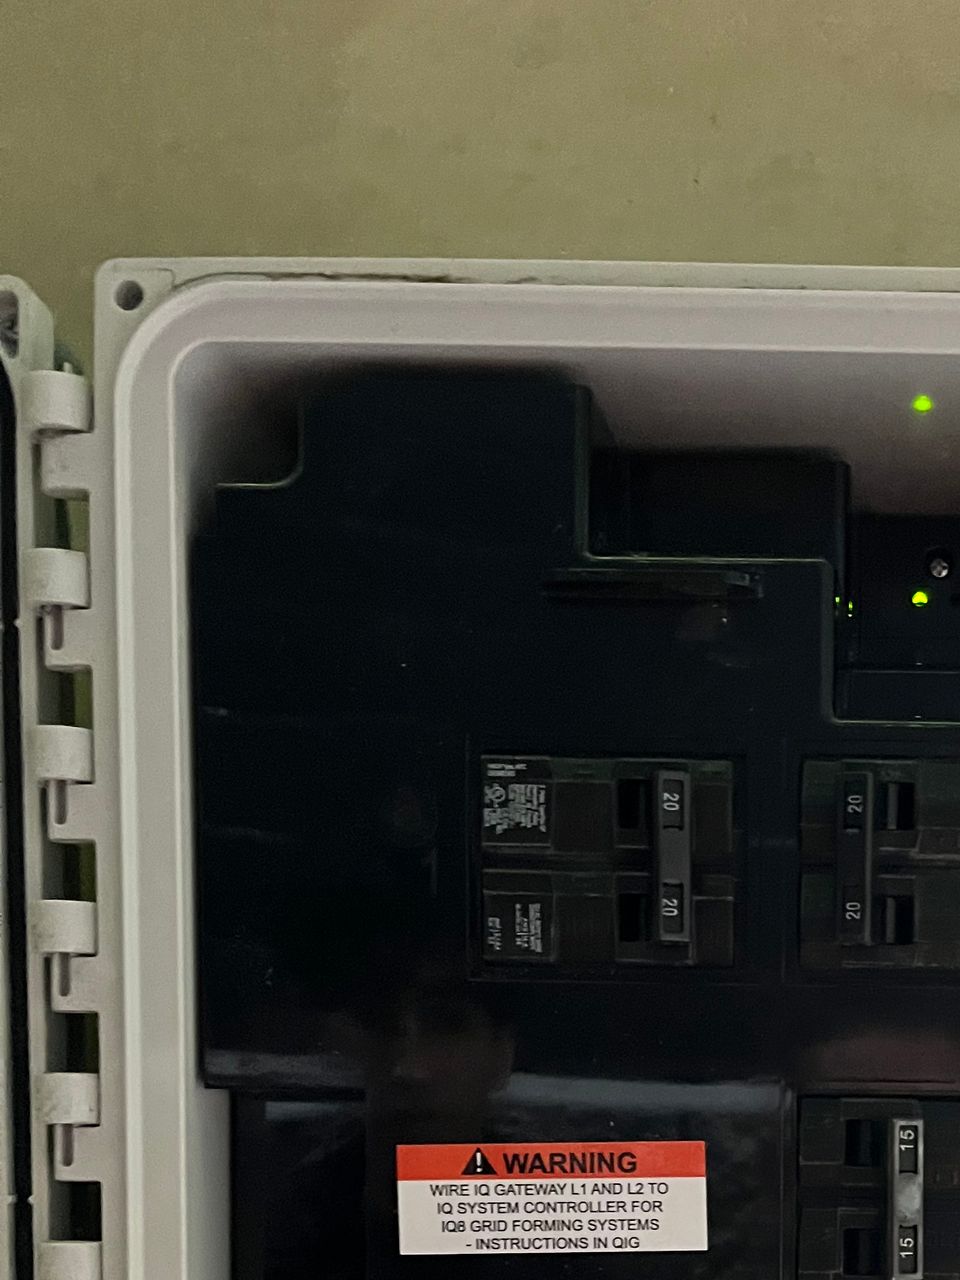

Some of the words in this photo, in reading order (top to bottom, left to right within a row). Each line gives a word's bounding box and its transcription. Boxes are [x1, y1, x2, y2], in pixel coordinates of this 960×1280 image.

[664, 793, 679, 810] 20
[847, 795, 863, 814] 20
[662, 898, 677, 916] 20
[845, 902, 861, 920] 20
[900, 1130, 914, 1152] 15
[503, 1152, 636, 1174] WARNING
[430, 1184, 470, 1197] WIRE
[474, 1184, 490, 1196] IQ
[494, 1183, 567, 1196] GATEWAY
[571, 1183, 586, 1195] L1
[591, 1183, 623, 1195] AND
[628, 1183, 644, 1194] L2
[648, 1182, 668, 1194] TO
[437, 1202, 453, 1215] IQ
[457, 1202, 519, 1214] SYSTEM
[524, 1201, 627, 1213] CONTROLLER
[631, 1201, 663, 1212] FOR
[442, 1221, 466, 1232] IQ8
[470, 1220, 507, 1232] GRID
[512, 1219, 583, 1232] FORMING
[588, 1219, 659, 1231] SYSTEMS
[476, 1237, 588, 1249] INSTRUCTIONS
[594, 1237, 607, 1248] IN
[612, 1237, 640, 1249] QIG
[900, 1237, 914, 1258] 15
